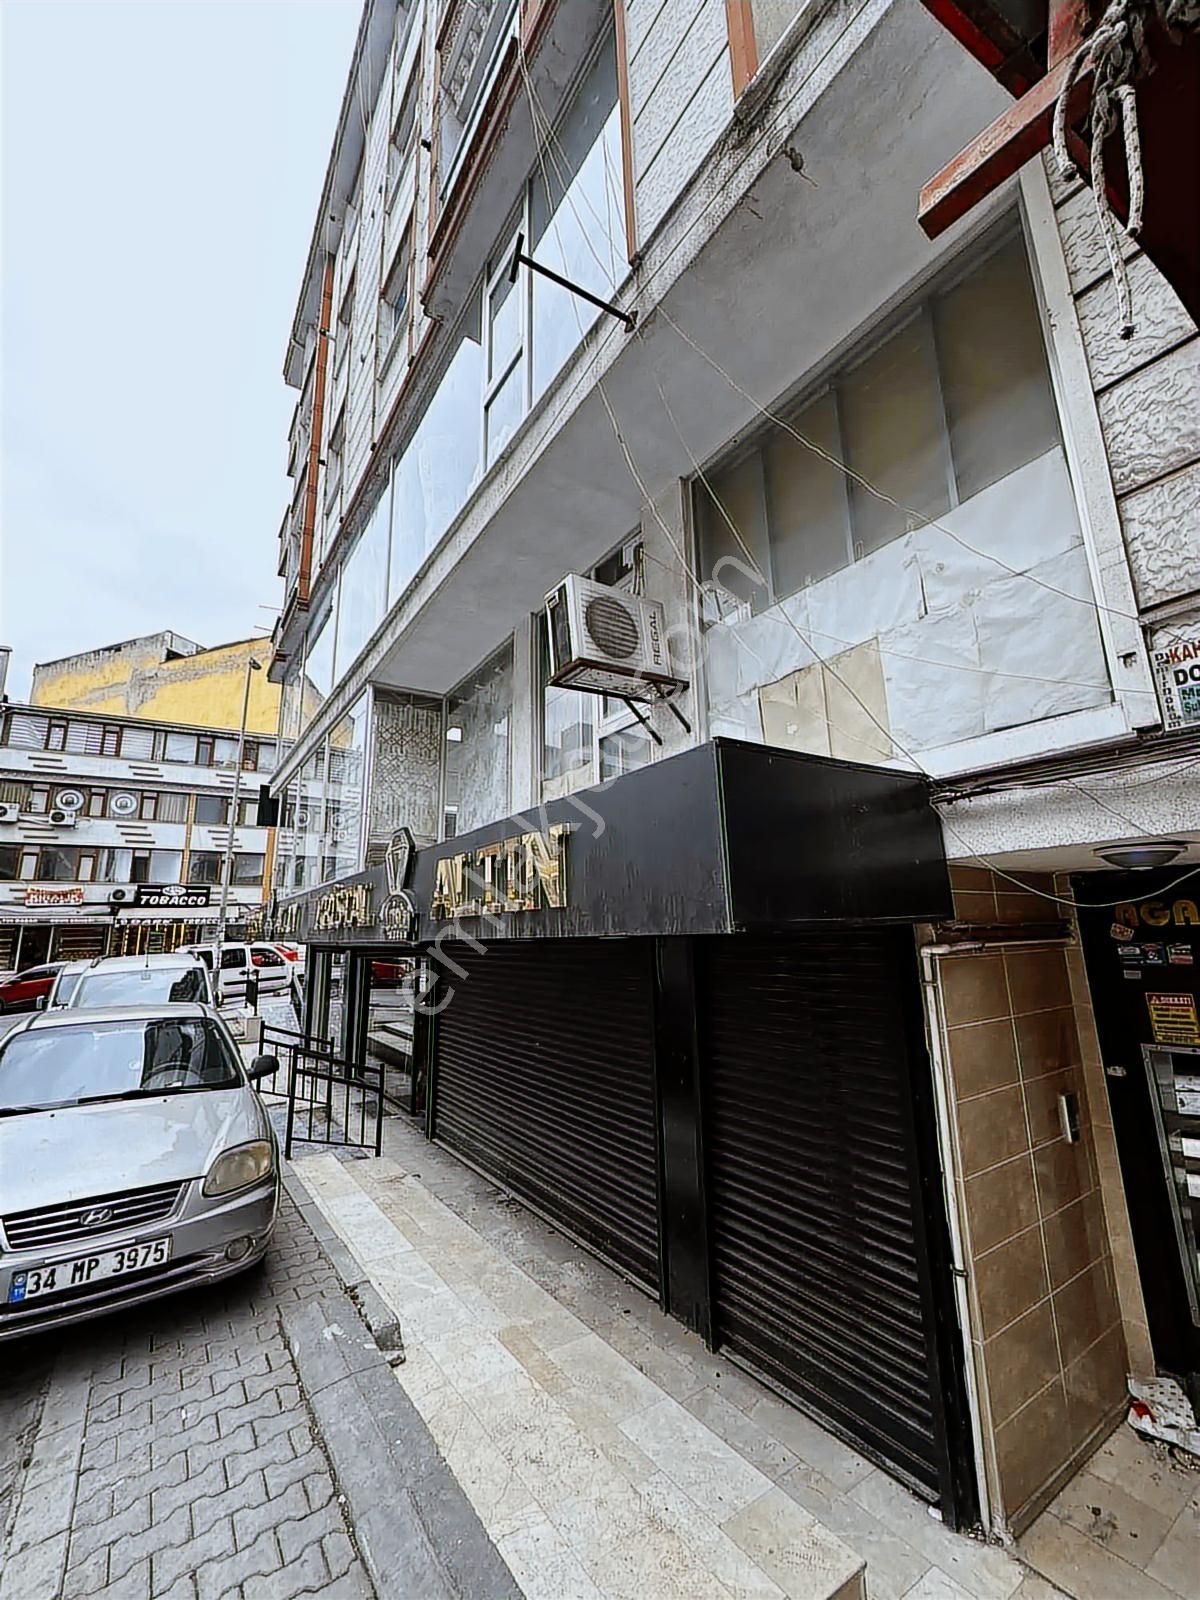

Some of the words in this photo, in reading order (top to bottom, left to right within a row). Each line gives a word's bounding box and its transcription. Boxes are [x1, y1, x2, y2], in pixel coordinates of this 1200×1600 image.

[649, 611, 662, 666] REGAL
[430, 821, 571, 921] ALTIN
[140, 895, 206, 906] TOBACCO
[27, 1270, 56, 1295] 34
[70, 1258, 100, 1284] MP
[112, 1240, 166, 1274] 3975
